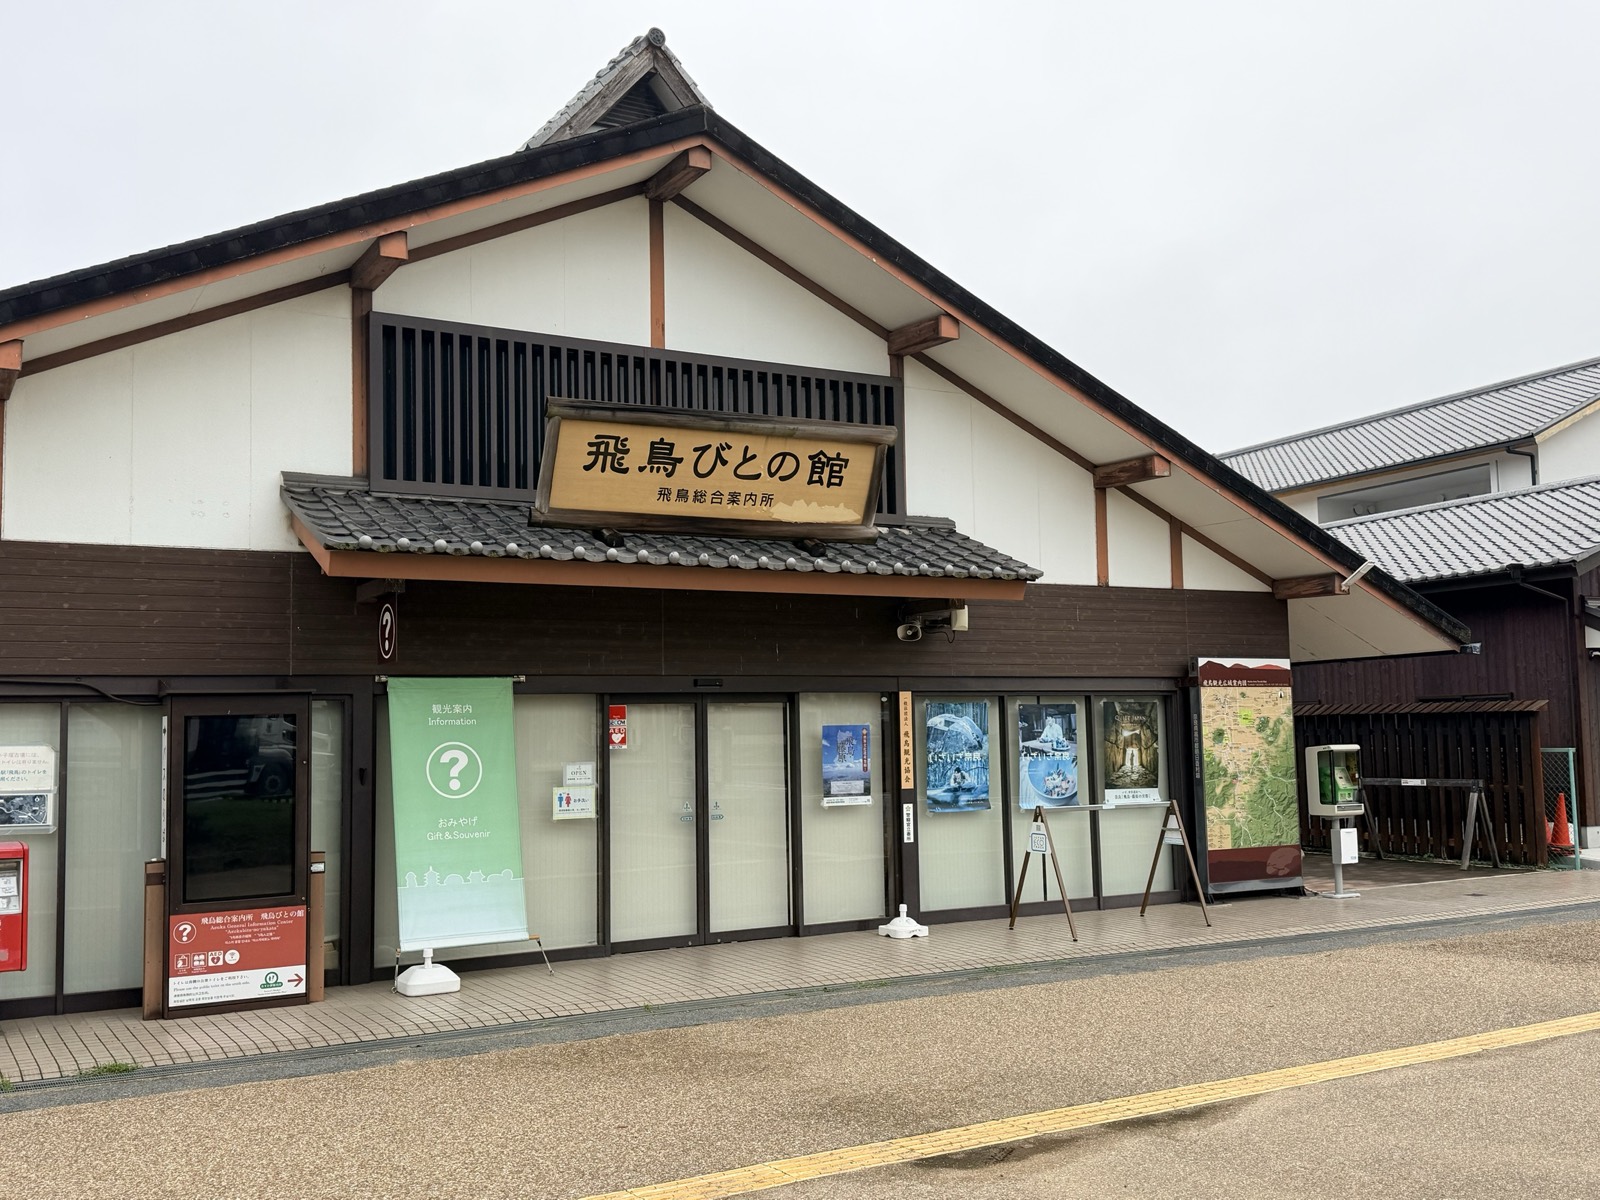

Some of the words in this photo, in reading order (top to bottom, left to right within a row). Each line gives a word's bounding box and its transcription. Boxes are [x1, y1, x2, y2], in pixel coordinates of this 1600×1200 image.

[582, 434, 850, 489] 飛鳥びとの館
[656, 486, 775, 508] 飛鳥総合案内所
[431, 703, 473, 714] 観光案内
[428, 717, 477, 726] Information
[903, 730, 911, 784] 飛鳥観光協会
[438, 816, 478, 828] おみやげ
[427, 831, 443, 840] Gift
[453, 829, 491, 840] Souvenir
[200, 913, 254, 925] 飛鳥総合案内所
[260, 909, 305, 920] 飛鳥びとの館
